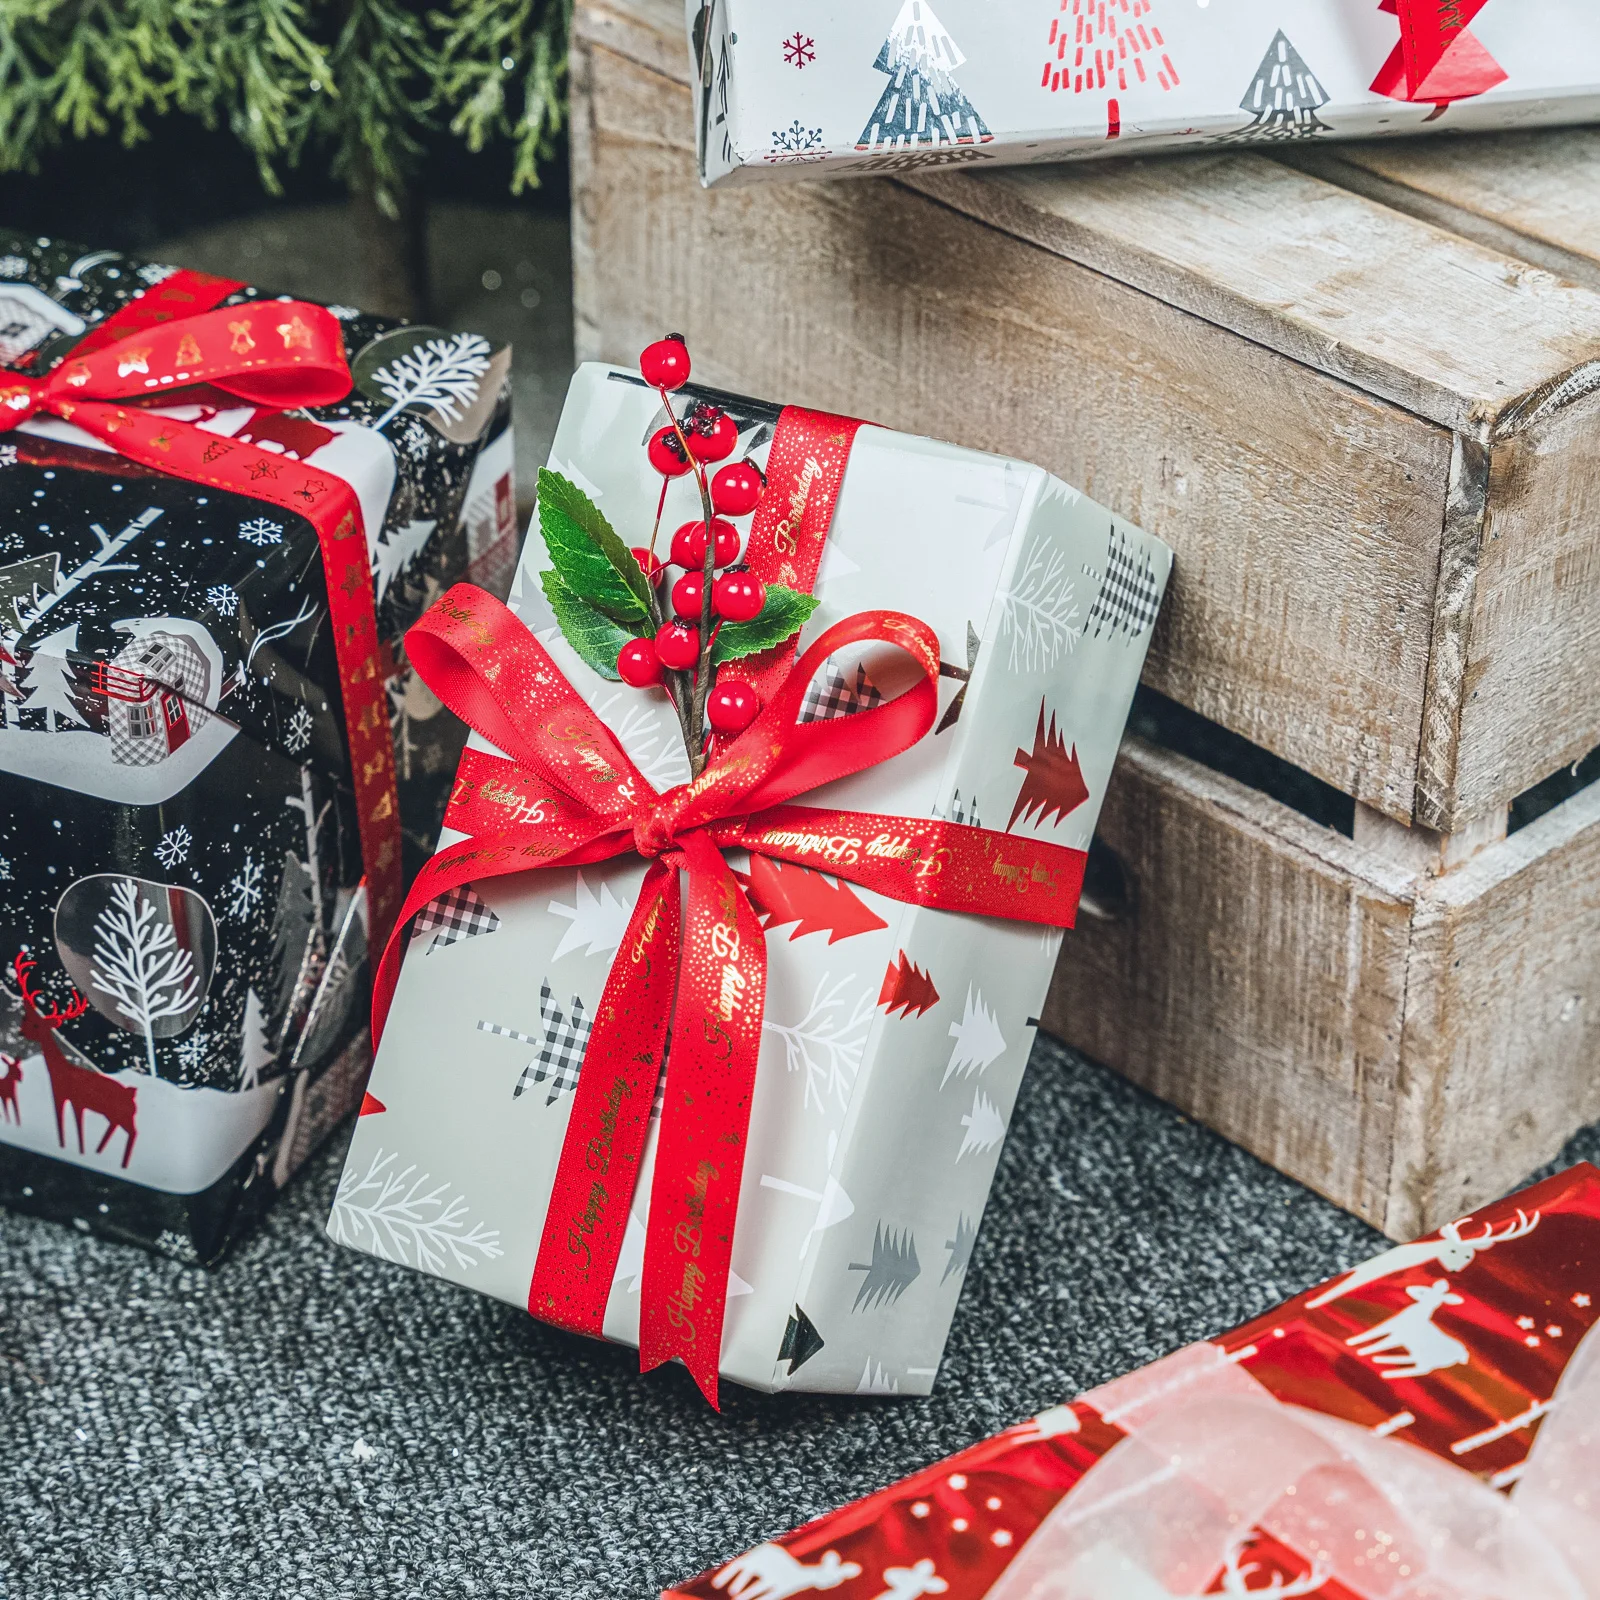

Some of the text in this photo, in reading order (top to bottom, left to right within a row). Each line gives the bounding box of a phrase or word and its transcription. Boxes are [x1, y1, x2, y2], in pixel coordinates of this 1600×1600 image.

[774, 456, 822, 556] Birthday
[479, 778, 559, 825] Happy
[762, 826, 953, 878] Happy Birthday
[703, 963, 746, 1061] Happy
[567, 1075, 633, 1271] Happy Birthday
[666, 1159, 720, 1342] Happy Birthday
